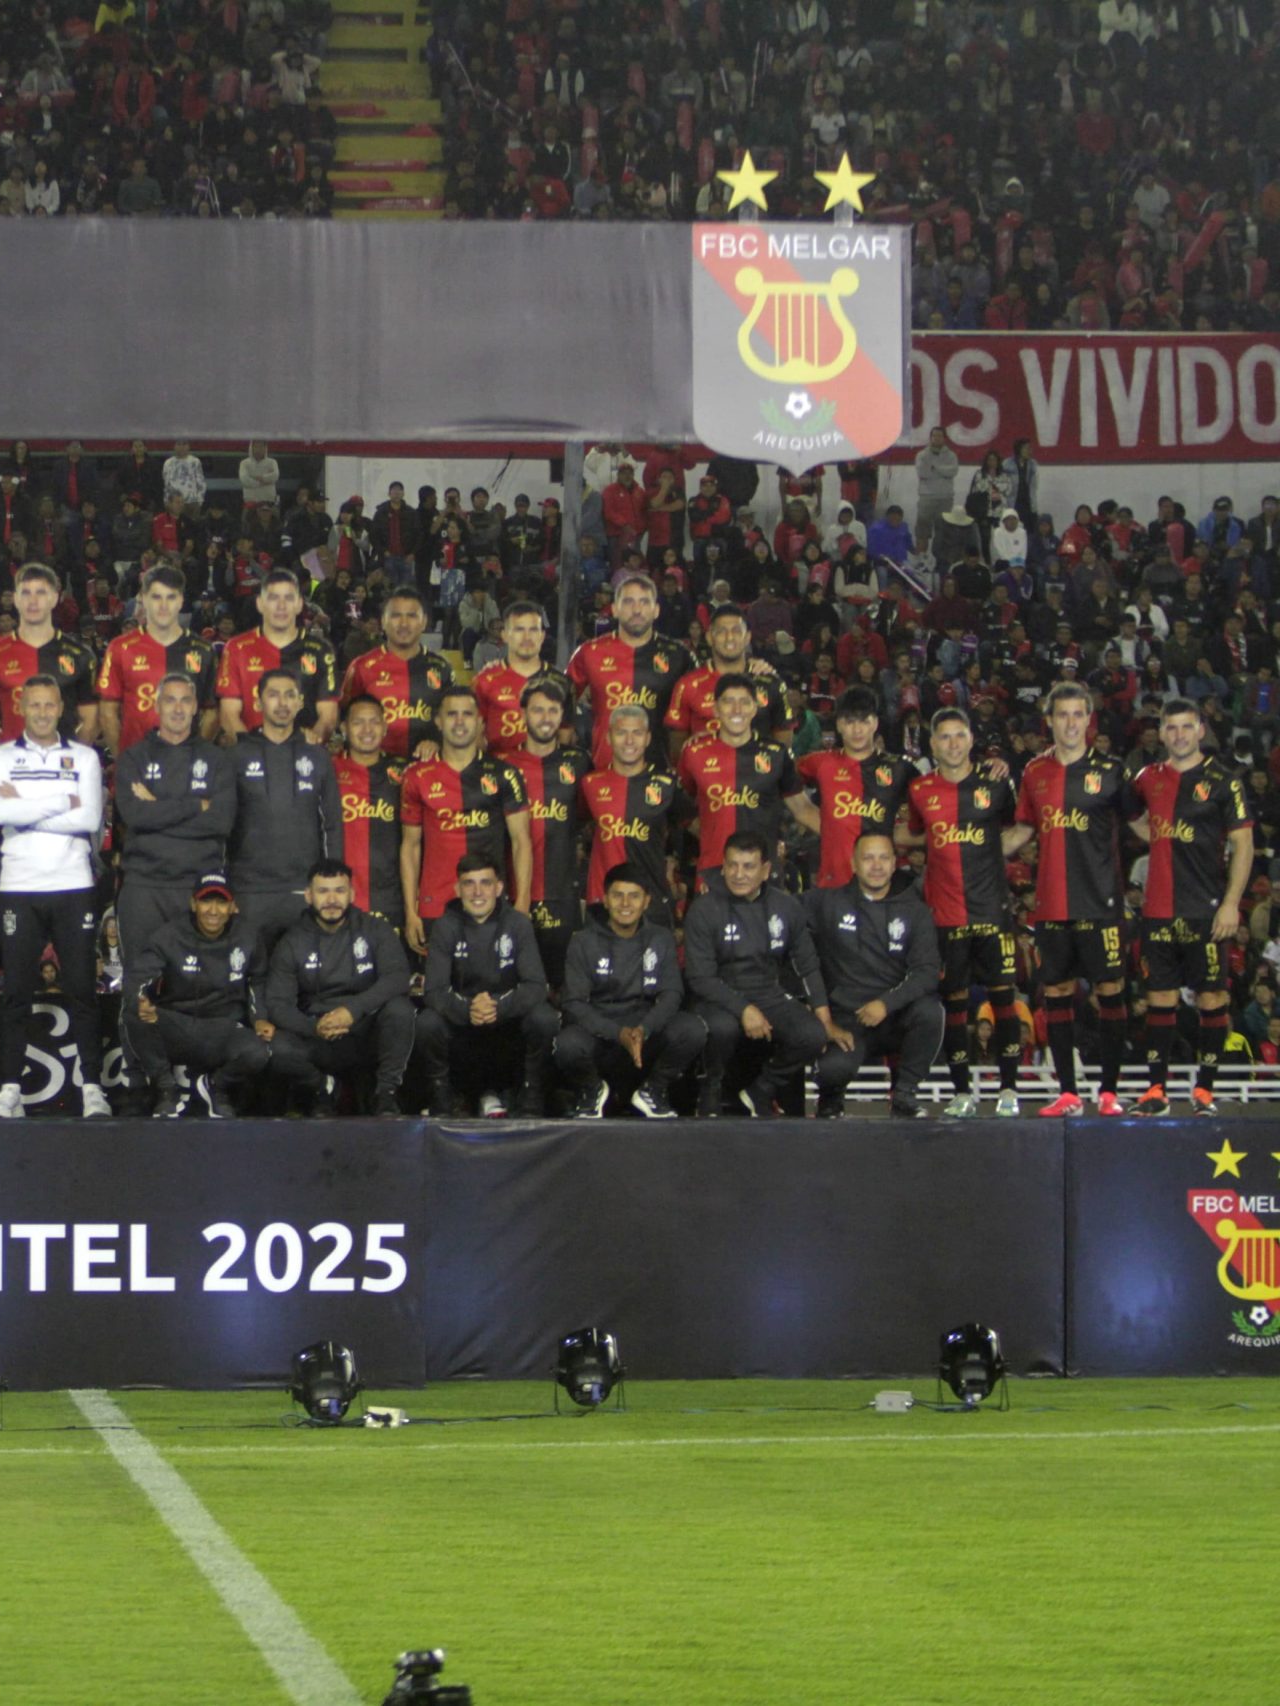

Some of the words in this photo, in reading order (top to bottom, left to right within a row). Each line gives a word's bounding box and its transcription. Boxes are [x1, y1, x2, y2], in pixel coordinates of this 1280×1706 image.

[701, 233, 759, 260] FBC
[767, 234, 891, 261] MELGAR
[1019, 344, 1280, 448] VIVIDO
[753, 430, 845, 452] AREQUIPA
[606, 681, 657, 709] Stake
[383, 696, 432, 724] Stake
[341, 793, 394, 822] Stake
[528, 798, 568, 821] take
[707, 783, 759, 812] Stake
[833, 791, 886, 823] Stake
[437, 807, 490, 832] Stake
[599, 812, 650, 842] Stake
[1041, 804, 1089, 832] Stake
[1151, 815, 1195, 844] Stake
[931, 820, 985, 849] Stake
[1102, 926, 1120, 952] 15
[1192, 1195, 1234, 1213] FBC
[201, 1222, 408, 1293] 2025
